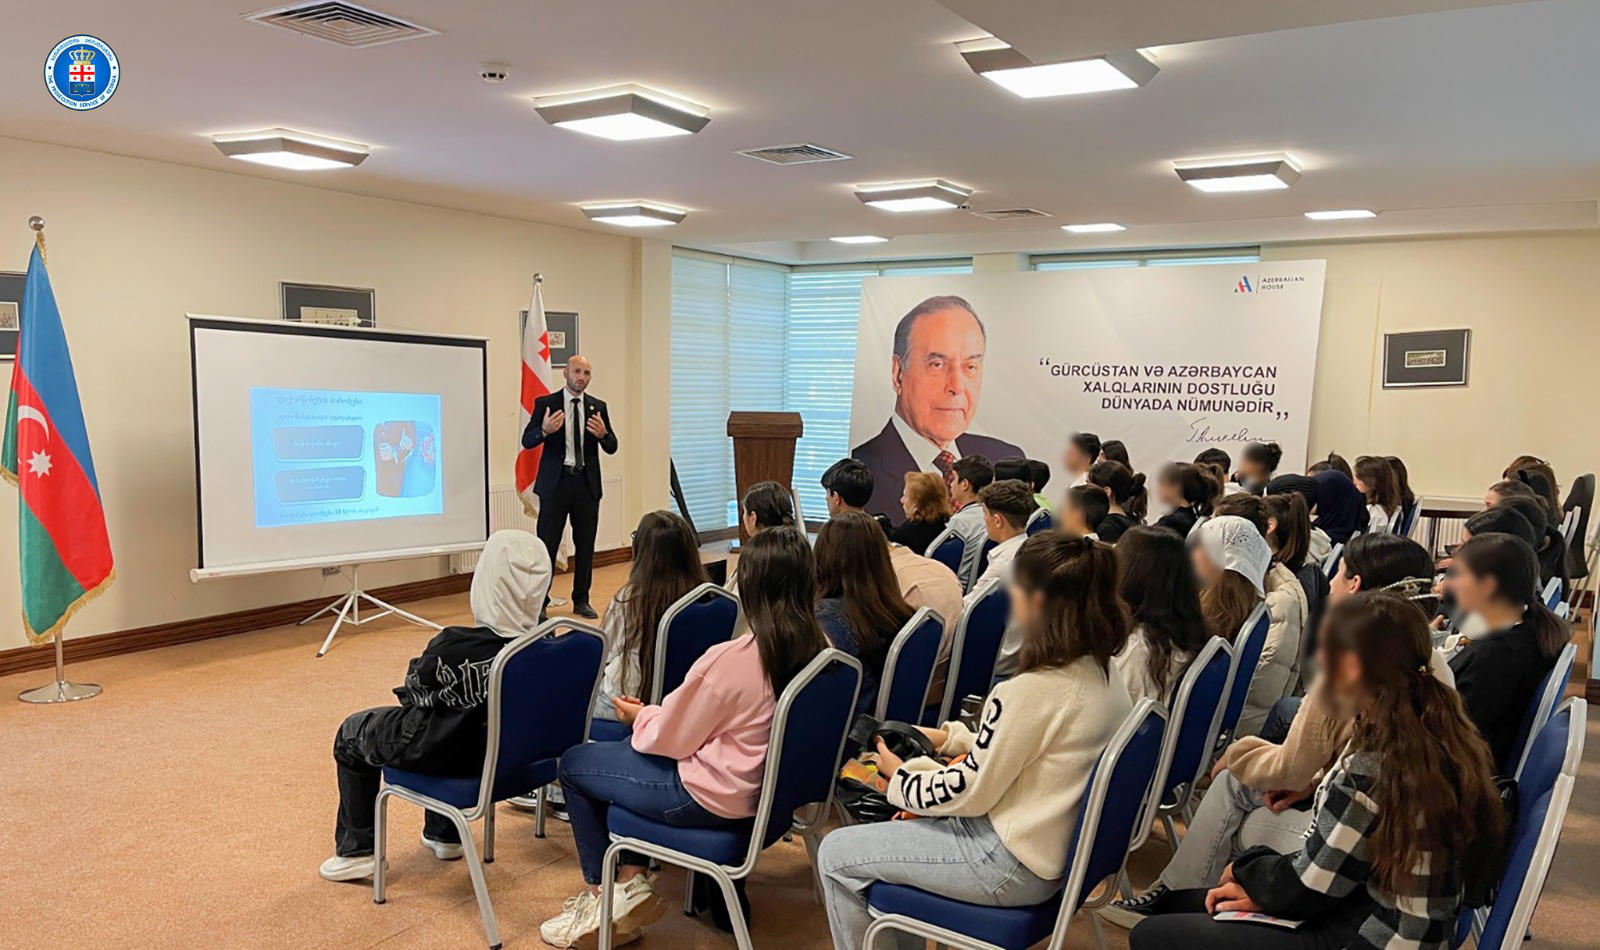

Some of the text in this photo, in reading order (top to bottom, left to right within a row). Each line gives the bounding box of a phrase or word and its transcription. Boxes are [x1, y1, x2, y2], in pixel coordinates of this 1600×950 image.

[1143, 366, 1164, 377] VƏ
[1167, 366, 1277, 379] AZƏRBAYCAN
[1083, 381, 1276, 396] XALQLARININ DOSTLUĞU
[1101, 396, 1173, 411] DÜNYADA
